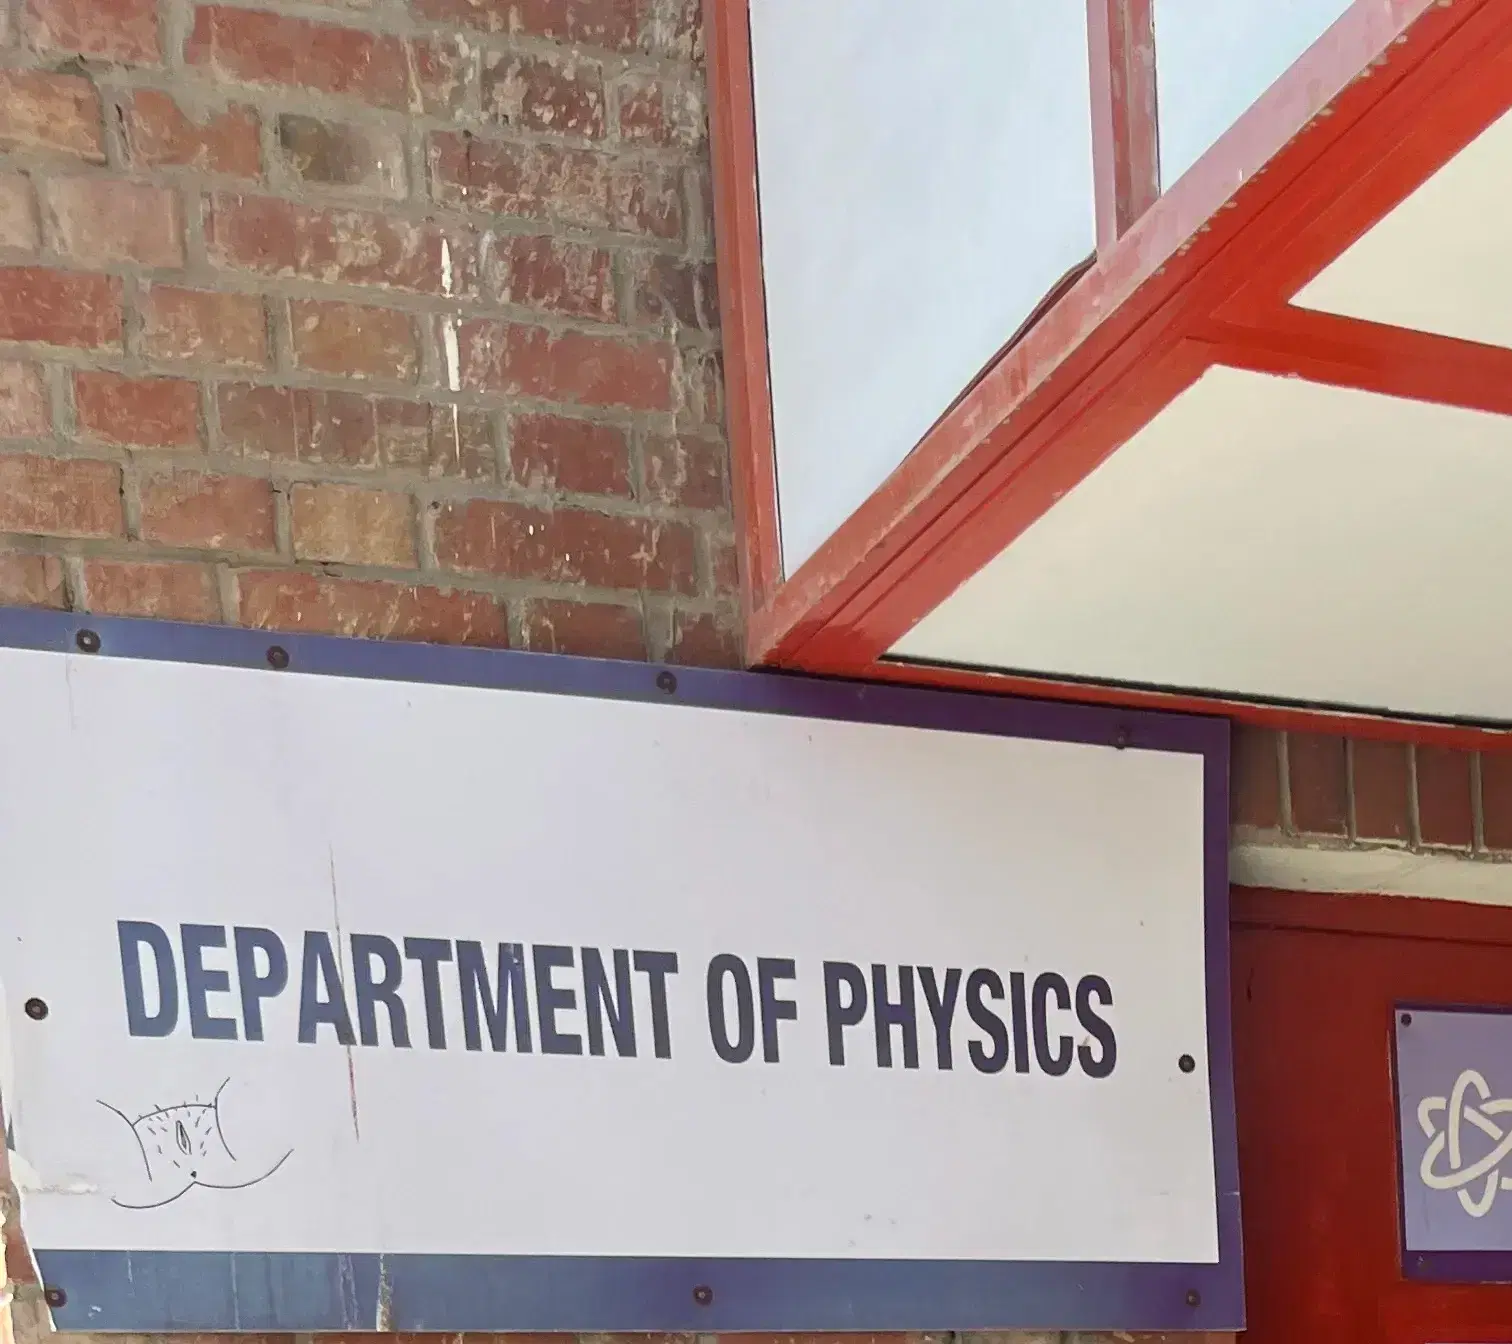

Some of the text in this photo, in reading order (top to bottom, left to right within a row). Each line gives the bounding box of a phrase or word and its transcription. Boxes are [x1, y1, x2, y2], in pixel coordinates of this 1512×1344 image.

[116, 919, 1117, 1079] DEPARTMENT OF PHYSICS
